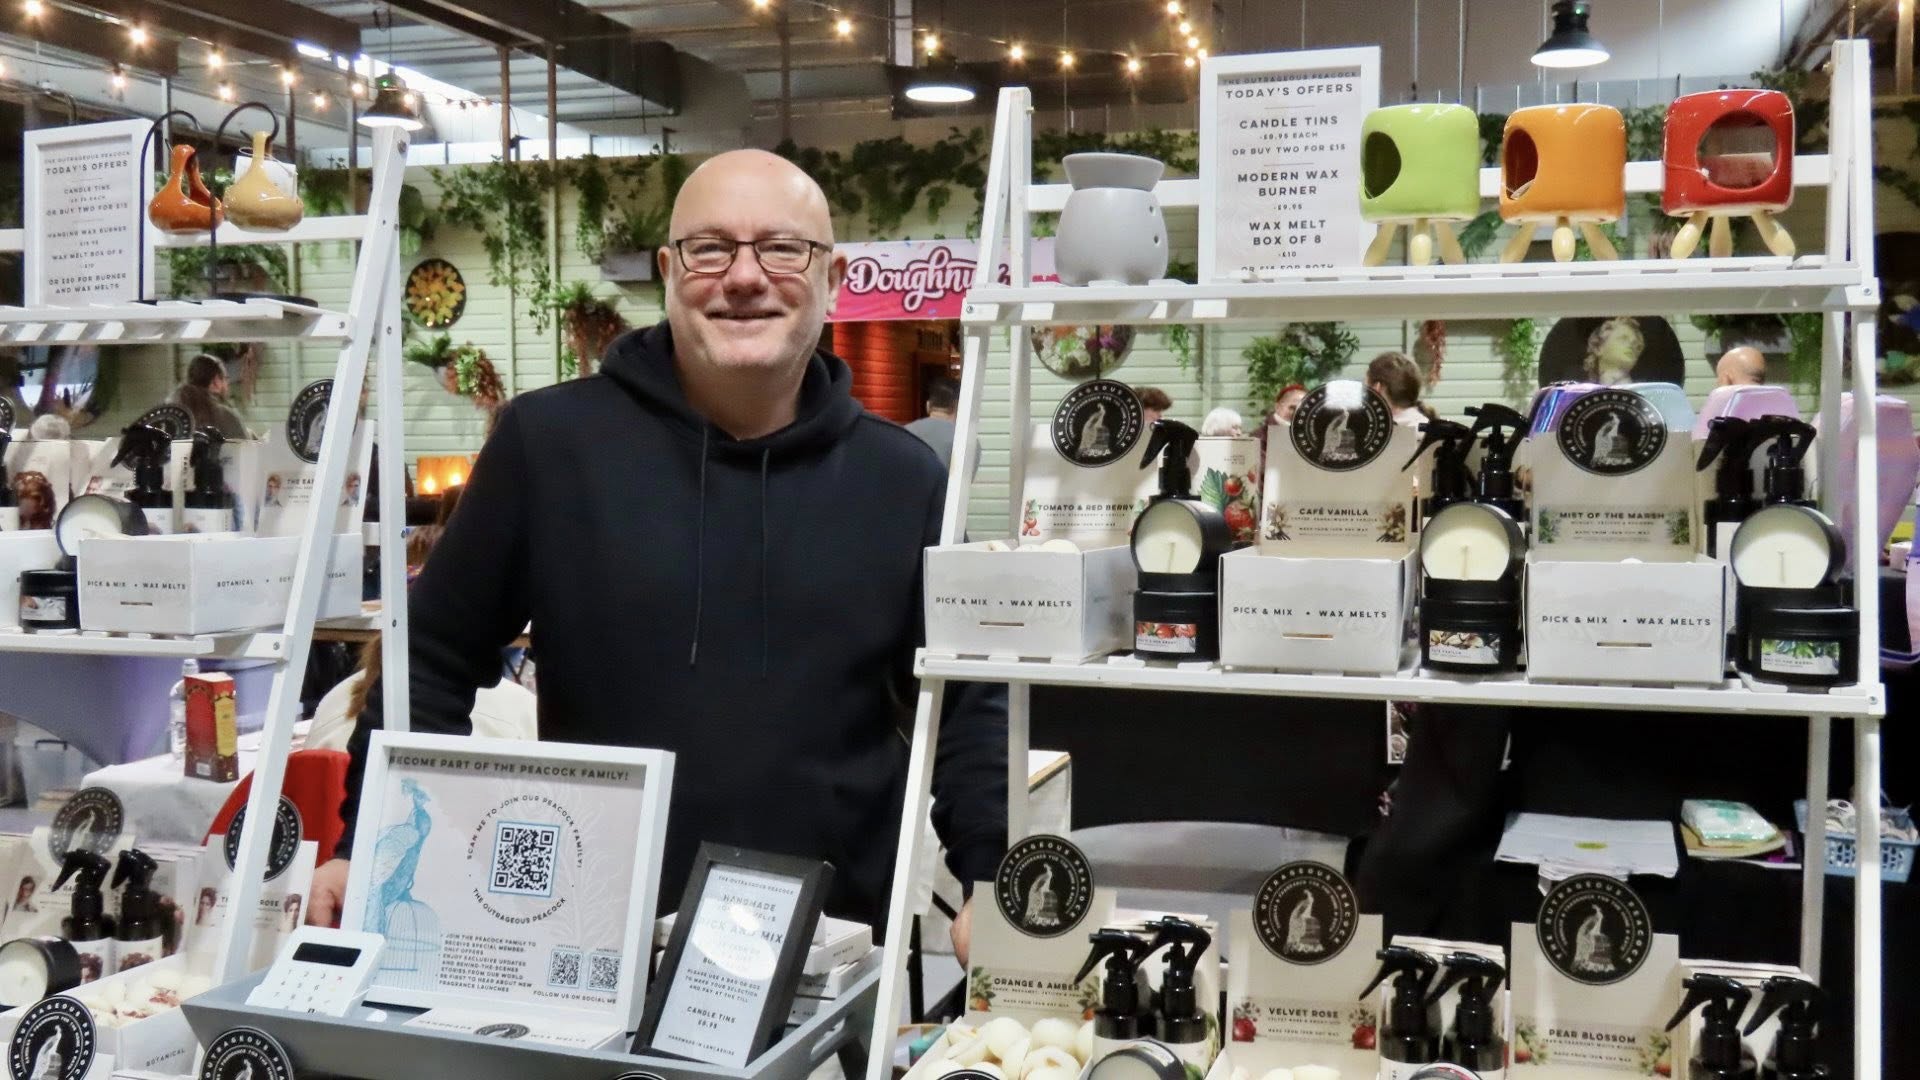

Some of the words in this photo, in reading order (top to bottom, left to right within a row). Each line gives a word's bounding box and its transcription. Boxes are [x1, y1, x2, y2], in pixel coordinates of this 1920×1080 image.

[1244, 74, 1308, 84] OUTRAGEOUS
[1312, 71, 1356, 80] PEACOCK
[1226, 87, 1290, 99] TODAY'S
[1297, 83, 1353, 94] OFFERS
[1240, 118, 1297, 129] CANDLE
[1304, 116, 1338, 125] TINS
[1232, 148, 1245, 156] OR
[1250, 147, 1270, 155] BUY
[46, 164, 87, 175] TODAY'S
[92, 160, 128, 170] OFFERS
[1238, 172, 1298, 183] MODERN
[1306, 170, 1339, 179] WAX
[1258, 186, 1317, 196] BURNER
[1249, 221, 1281, 231] WAX
[1288, 220, 1326, 229] MELT
[1253, 236, 1282, 246] BOX
[1289, 235, 1307, 245] OF
[1314, 234, 1321, 244] 8
[848, 245, 1010, 312] Doughnu
[1300, 507, 1323, 515] CAFÉ
[217, 579, 254, 587] BOTANICAL
[1233, 606, 1257, 614] PICK
[1274, 608, 1292, 616] MIX
[1587, 616, 1608, 624] MIX
[1670, 618, 1710, 626] MELTS
[389, 756, 436, 767] BECOME
[440, 760, 470, 768] PART
[474, 762, 489, 770] OF
[494, 763, 515, 772] THE
[520, 765, 576, 777] PEACOCK
[581, 768, 628, 780] FAMILY!
[467, 835, 478, 860] SCAN
[476, 820, 486, 832] ME
[487, 808, 497, 818] TO
[500, 797, 518, 809] JOIN
[543, 798, 574, 826] PEACOCK
[473, 888, 484, 903] THE
[483, 903, 530, 924] OUTRAGEOUS
[532, 897, 565, 922] PEACOCK
[723, 894, 776, 912] HANDMADE
[761, 931, 783, 943] MIX
[994, 978, 1033, 988] ORANGE
[1047, 982, 1080, 991] AMBER
[582, 995, 605, 1003] SOCIAL
[687, 1006, 716, 1018] CANDLE
[719, 1013, 736, 1023] TINS
[1269, 1008, 1308, 1016] VELVET
[1312, 1010, 1338, 1018] ROSE
[1549, 1029, 1577, 1038] PEAR
[1582, 1032, 1636, 1043] BLOSSOM
[146, 1049, 184, 1066] BOTANICAL
